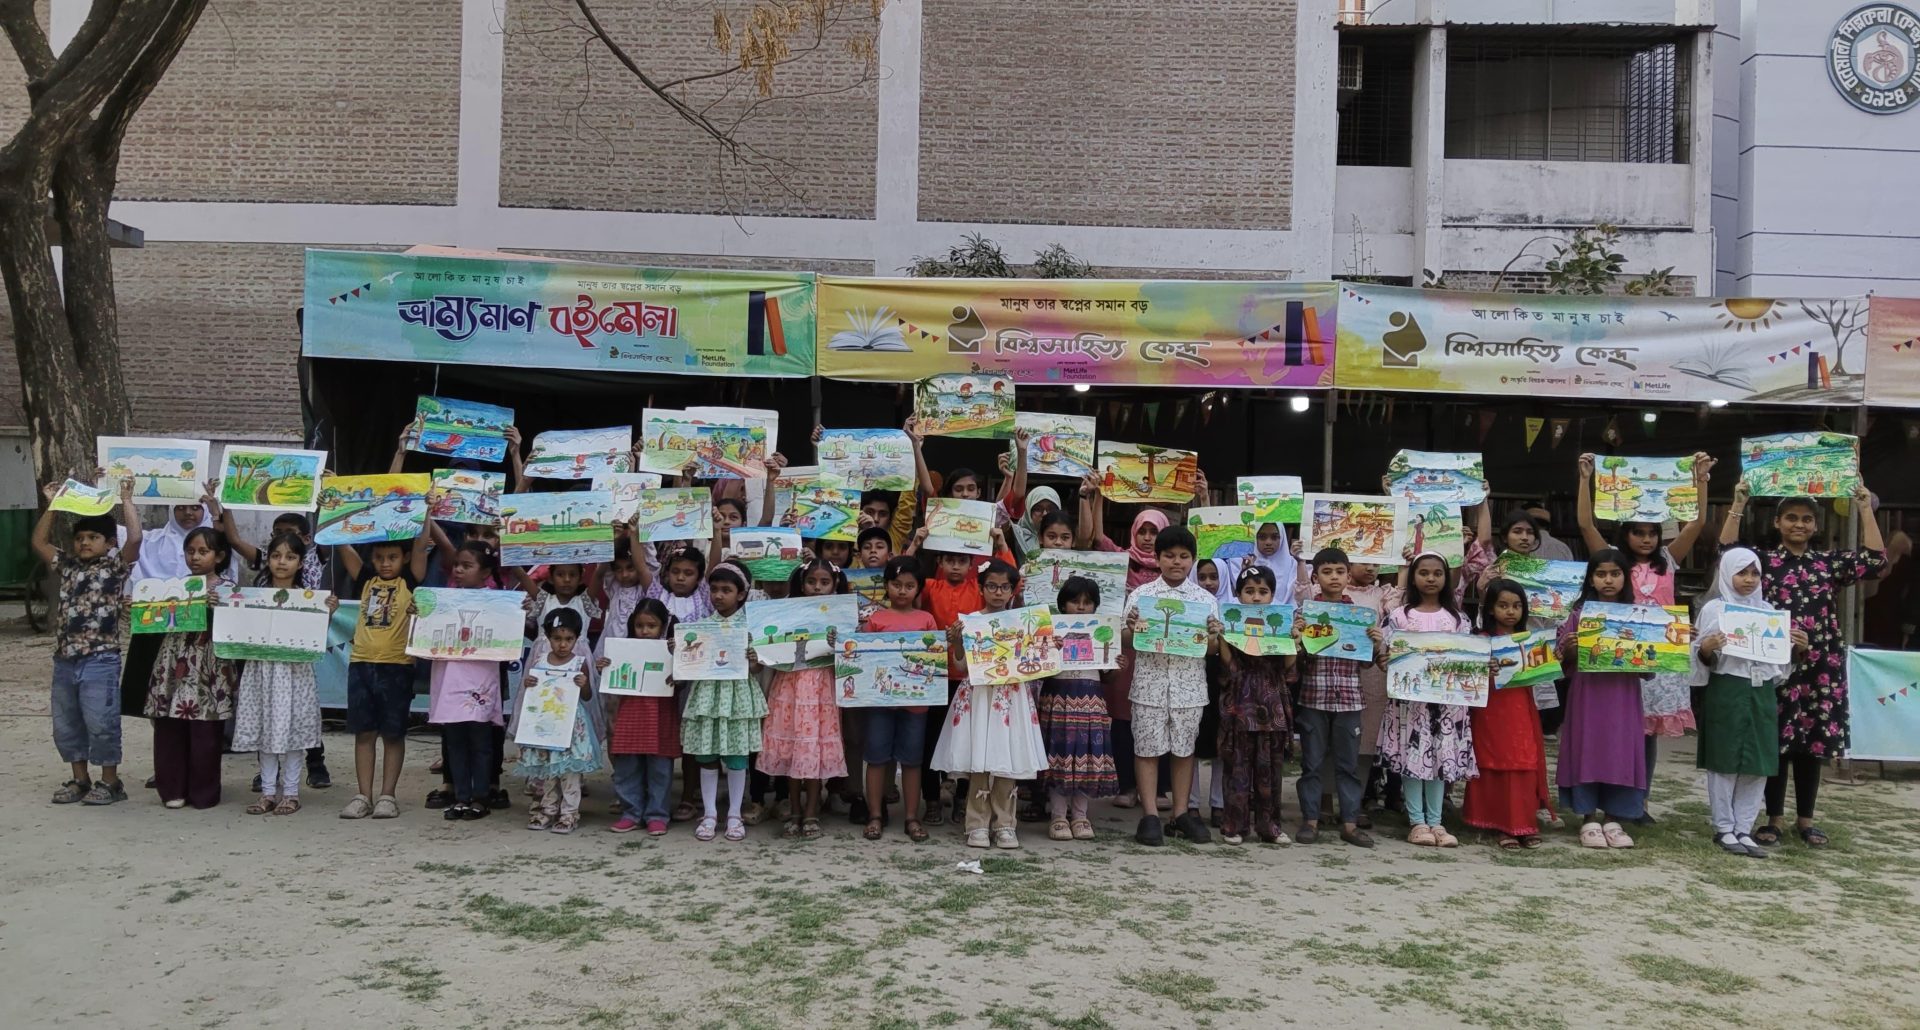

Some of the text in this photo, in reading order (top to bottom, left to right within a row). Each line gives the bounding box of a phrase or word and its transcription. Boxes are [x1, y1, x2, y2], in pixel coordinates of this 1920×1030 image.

[1861, 87, 1908, 108] ১৯২৪
[577, 280, 683, 295] মানুষ তার স্বপ্নের সমান বড়
[1000, 297, 1150, 314] মানুষ তার স্বপ্নের সমান বড়
[397, 293, 679, 350] ভ্রাম্যমাণ বইমেলা
[994, 327, 1213, 367] বিশ্বসাহিত্য কেন্দ্র
[1445, 331, 1639, 371] বিশ্বসাহিত্য কেন্দ্র
[701, 354, 726, 362] MetLife
[701, 360, 735, 368] Foundation
[1644, 382, 1671, 390] MetLife
